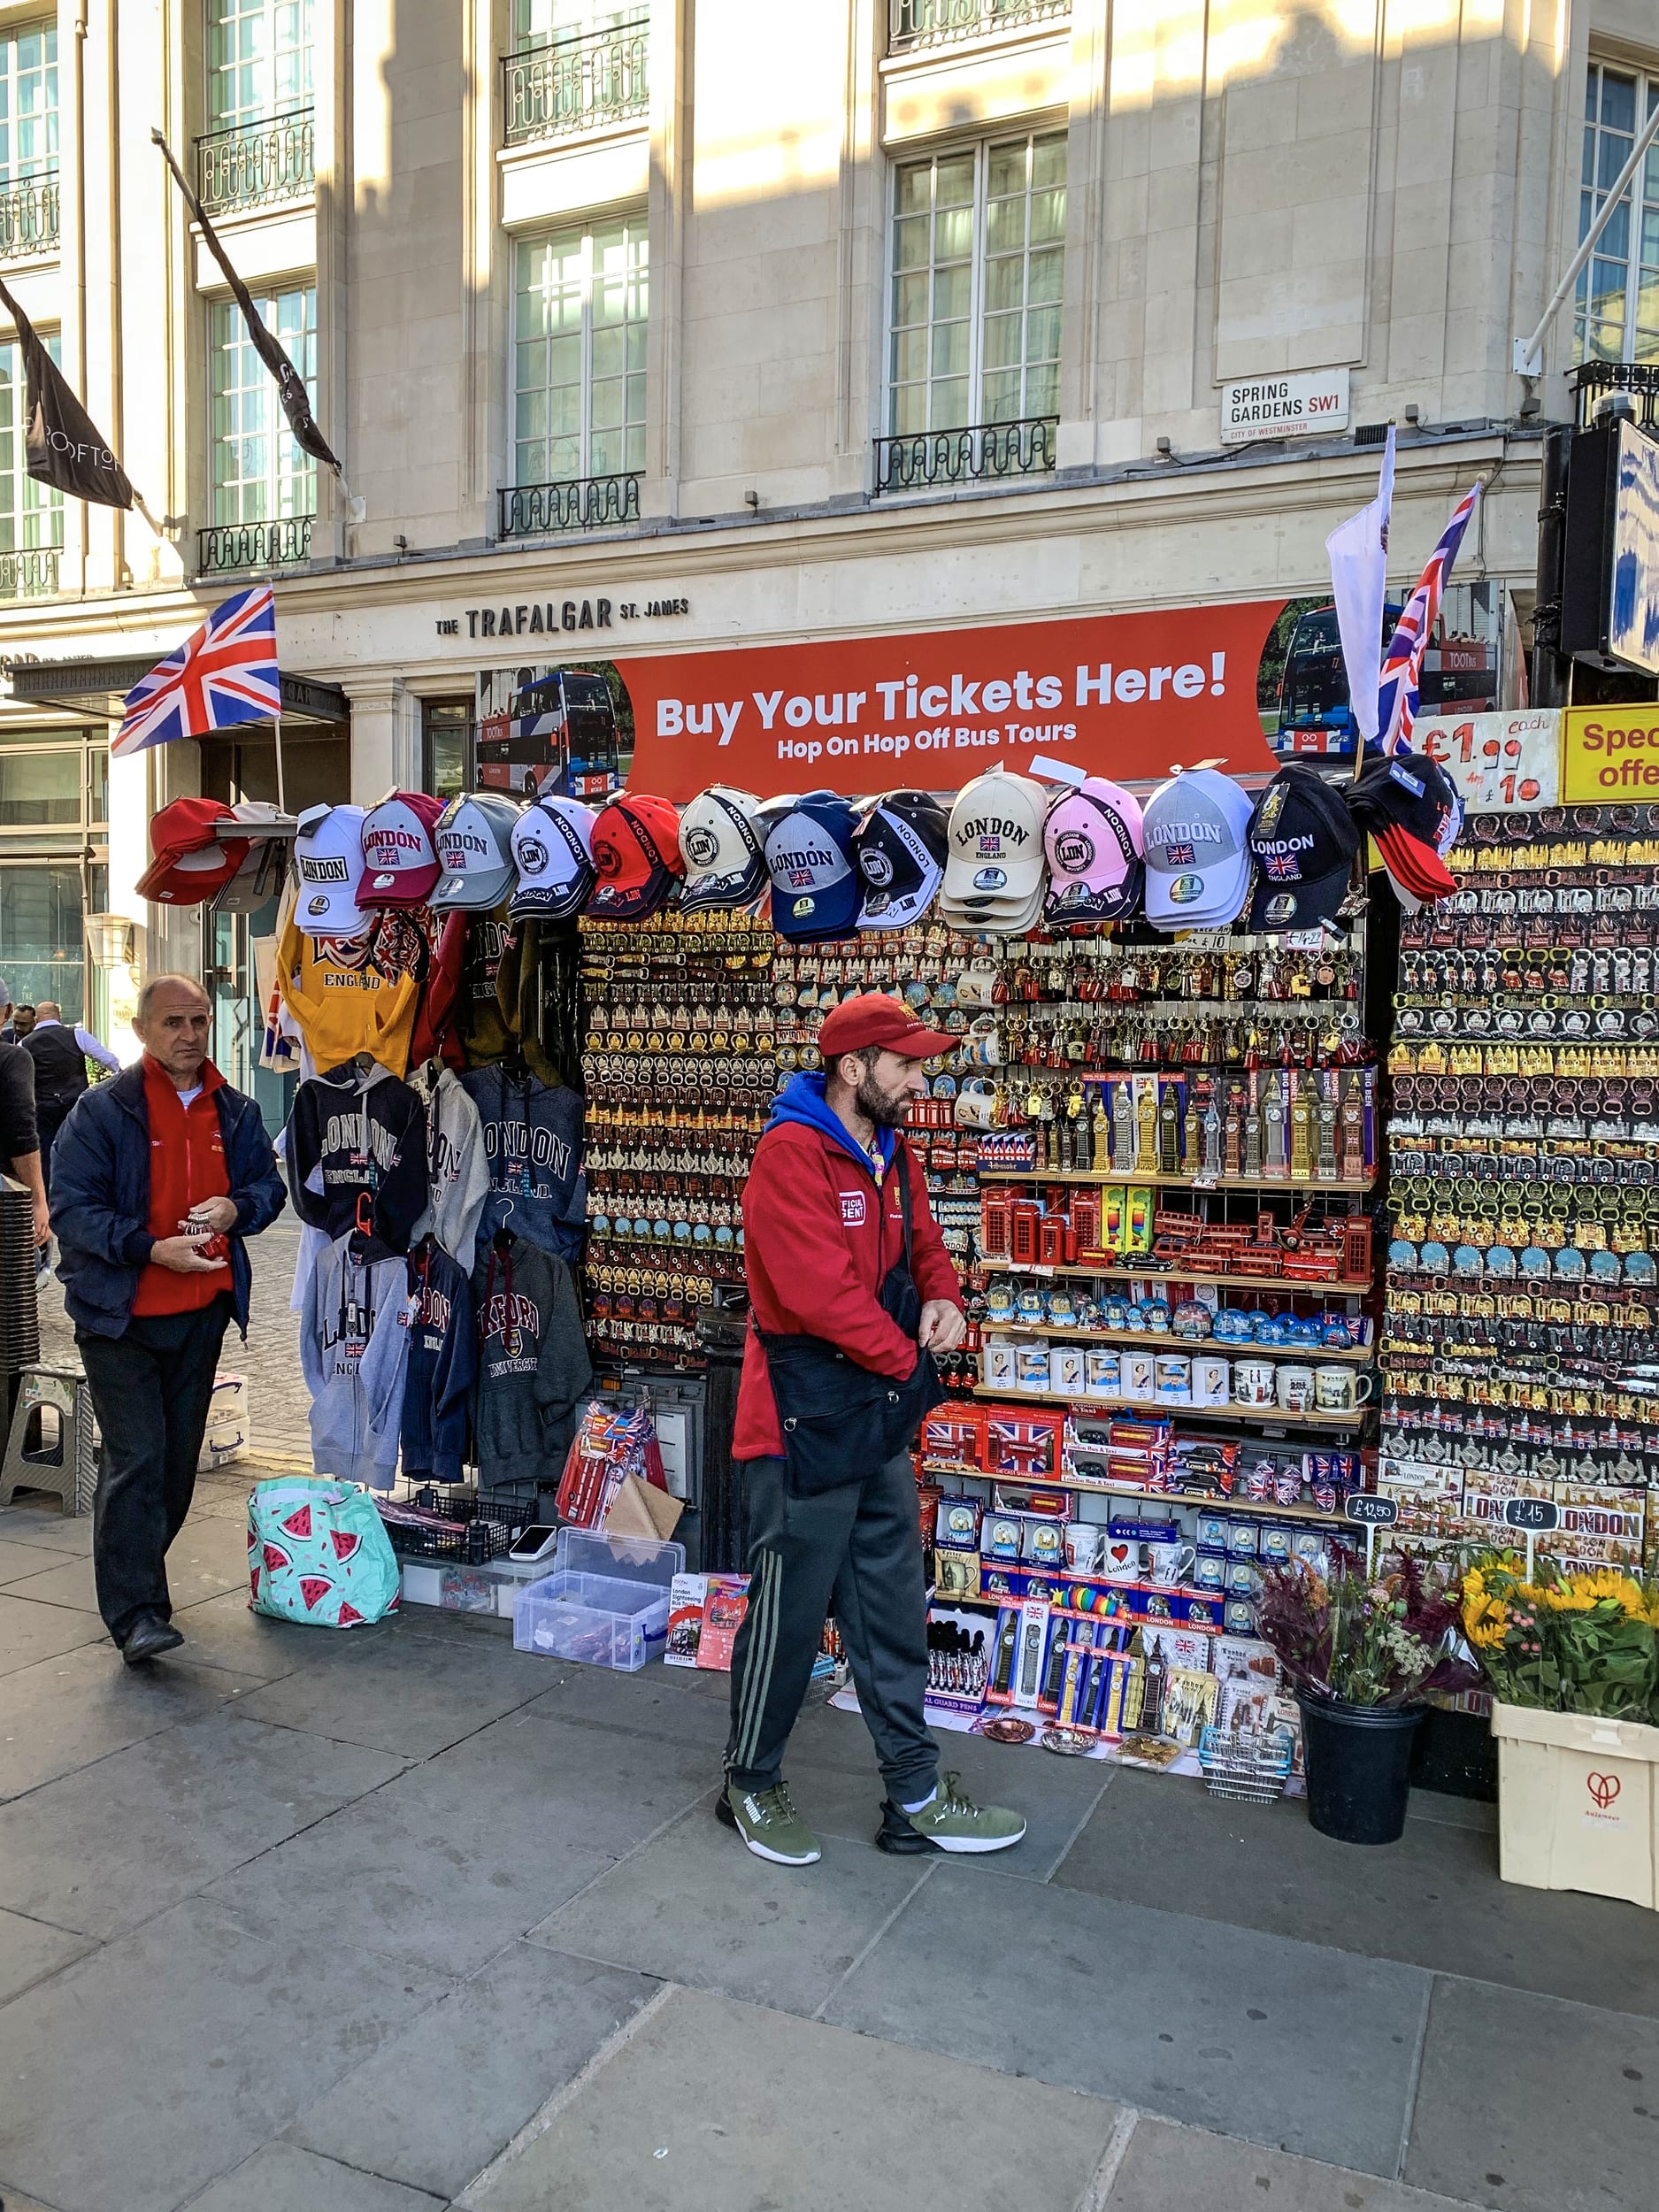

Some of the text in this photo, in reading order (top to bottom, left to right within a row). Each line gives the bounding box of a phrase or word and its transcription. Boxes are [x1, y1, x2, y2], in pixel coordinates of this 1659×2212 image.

[1232, 382, 1288, 404] SPRING
[1231, 395, 1339, 423] GARDENS SW1
[1231, 430, 1246, 440] CITY
[1258, 423, 1308, 436] WESTMINSTER
[435, 598, 689, 638] THE TRAFALGAR ST. JAMES
[657, 651, 1227, 747] Buy Your Tickets Here!
[1508, 715, 1549, 735] each
[777, 720, 1077, 763] Hop On Hop Off Bus Tours
[1499, 773, 1540, 804] 10
[555, 816, 583, 860] LONDON
[726, 806, 757, 851] LONDON
[955, 817, 1030, 848] LONDON
[1104, 808, 1133, 858] LONDON
[1146, 822, 1222, 847] LONDON
[363, 829, 422, 854] LONDON
[631, 819, 657, 864] LONDON
[691, 841, 710, 854] LDN
[896, 824, 931, 869] LONDON
[1251, 834, 1315, 853] LONDON
[522, 850, 541, 864] LDN
[769, 849, 835, 873] LONDON
[1061, 846, 1085, 860] LDN
[301, 860, 346, 879] LONDON
[864, 860, 884, 874] LDN
[726, 872, 744, 885] LDN
[1268, 872, 1302, 882] ENGLAND
[552, 884, 570, 896] LDN
[626, 889, 641, 902] LDN
[1104, 887, 1123, 903] LDN
[899, 896, 917, 911] LDN
[1212, 935, 1225, 949] 10
[1249, 1072, 1258, 1103] MONEY
[483, 1120, 572, 1181] ONDON
[944, 1241, 968, 1252] NDON
[477, 1293, 540, 1340] XFORD
[1403, 1471, 1426, 1481] LONDON
[1515, 1499, 1544, 1523] £15
[1107, 1560, 1137, 1573] London
[672, 1594, 702, 1603] Sightseeing
[1146, 1617, 1174, 1626] LONDON
[1187, 1623, 1217, 1633] LONDON
[933, 1698, 959, 1709] GUARD
[959, 1701, 978, 1712] PENS
[987, 1694, 1010, 1702] LONDON
[1038, 1701, 1059, 1710] LONDO
